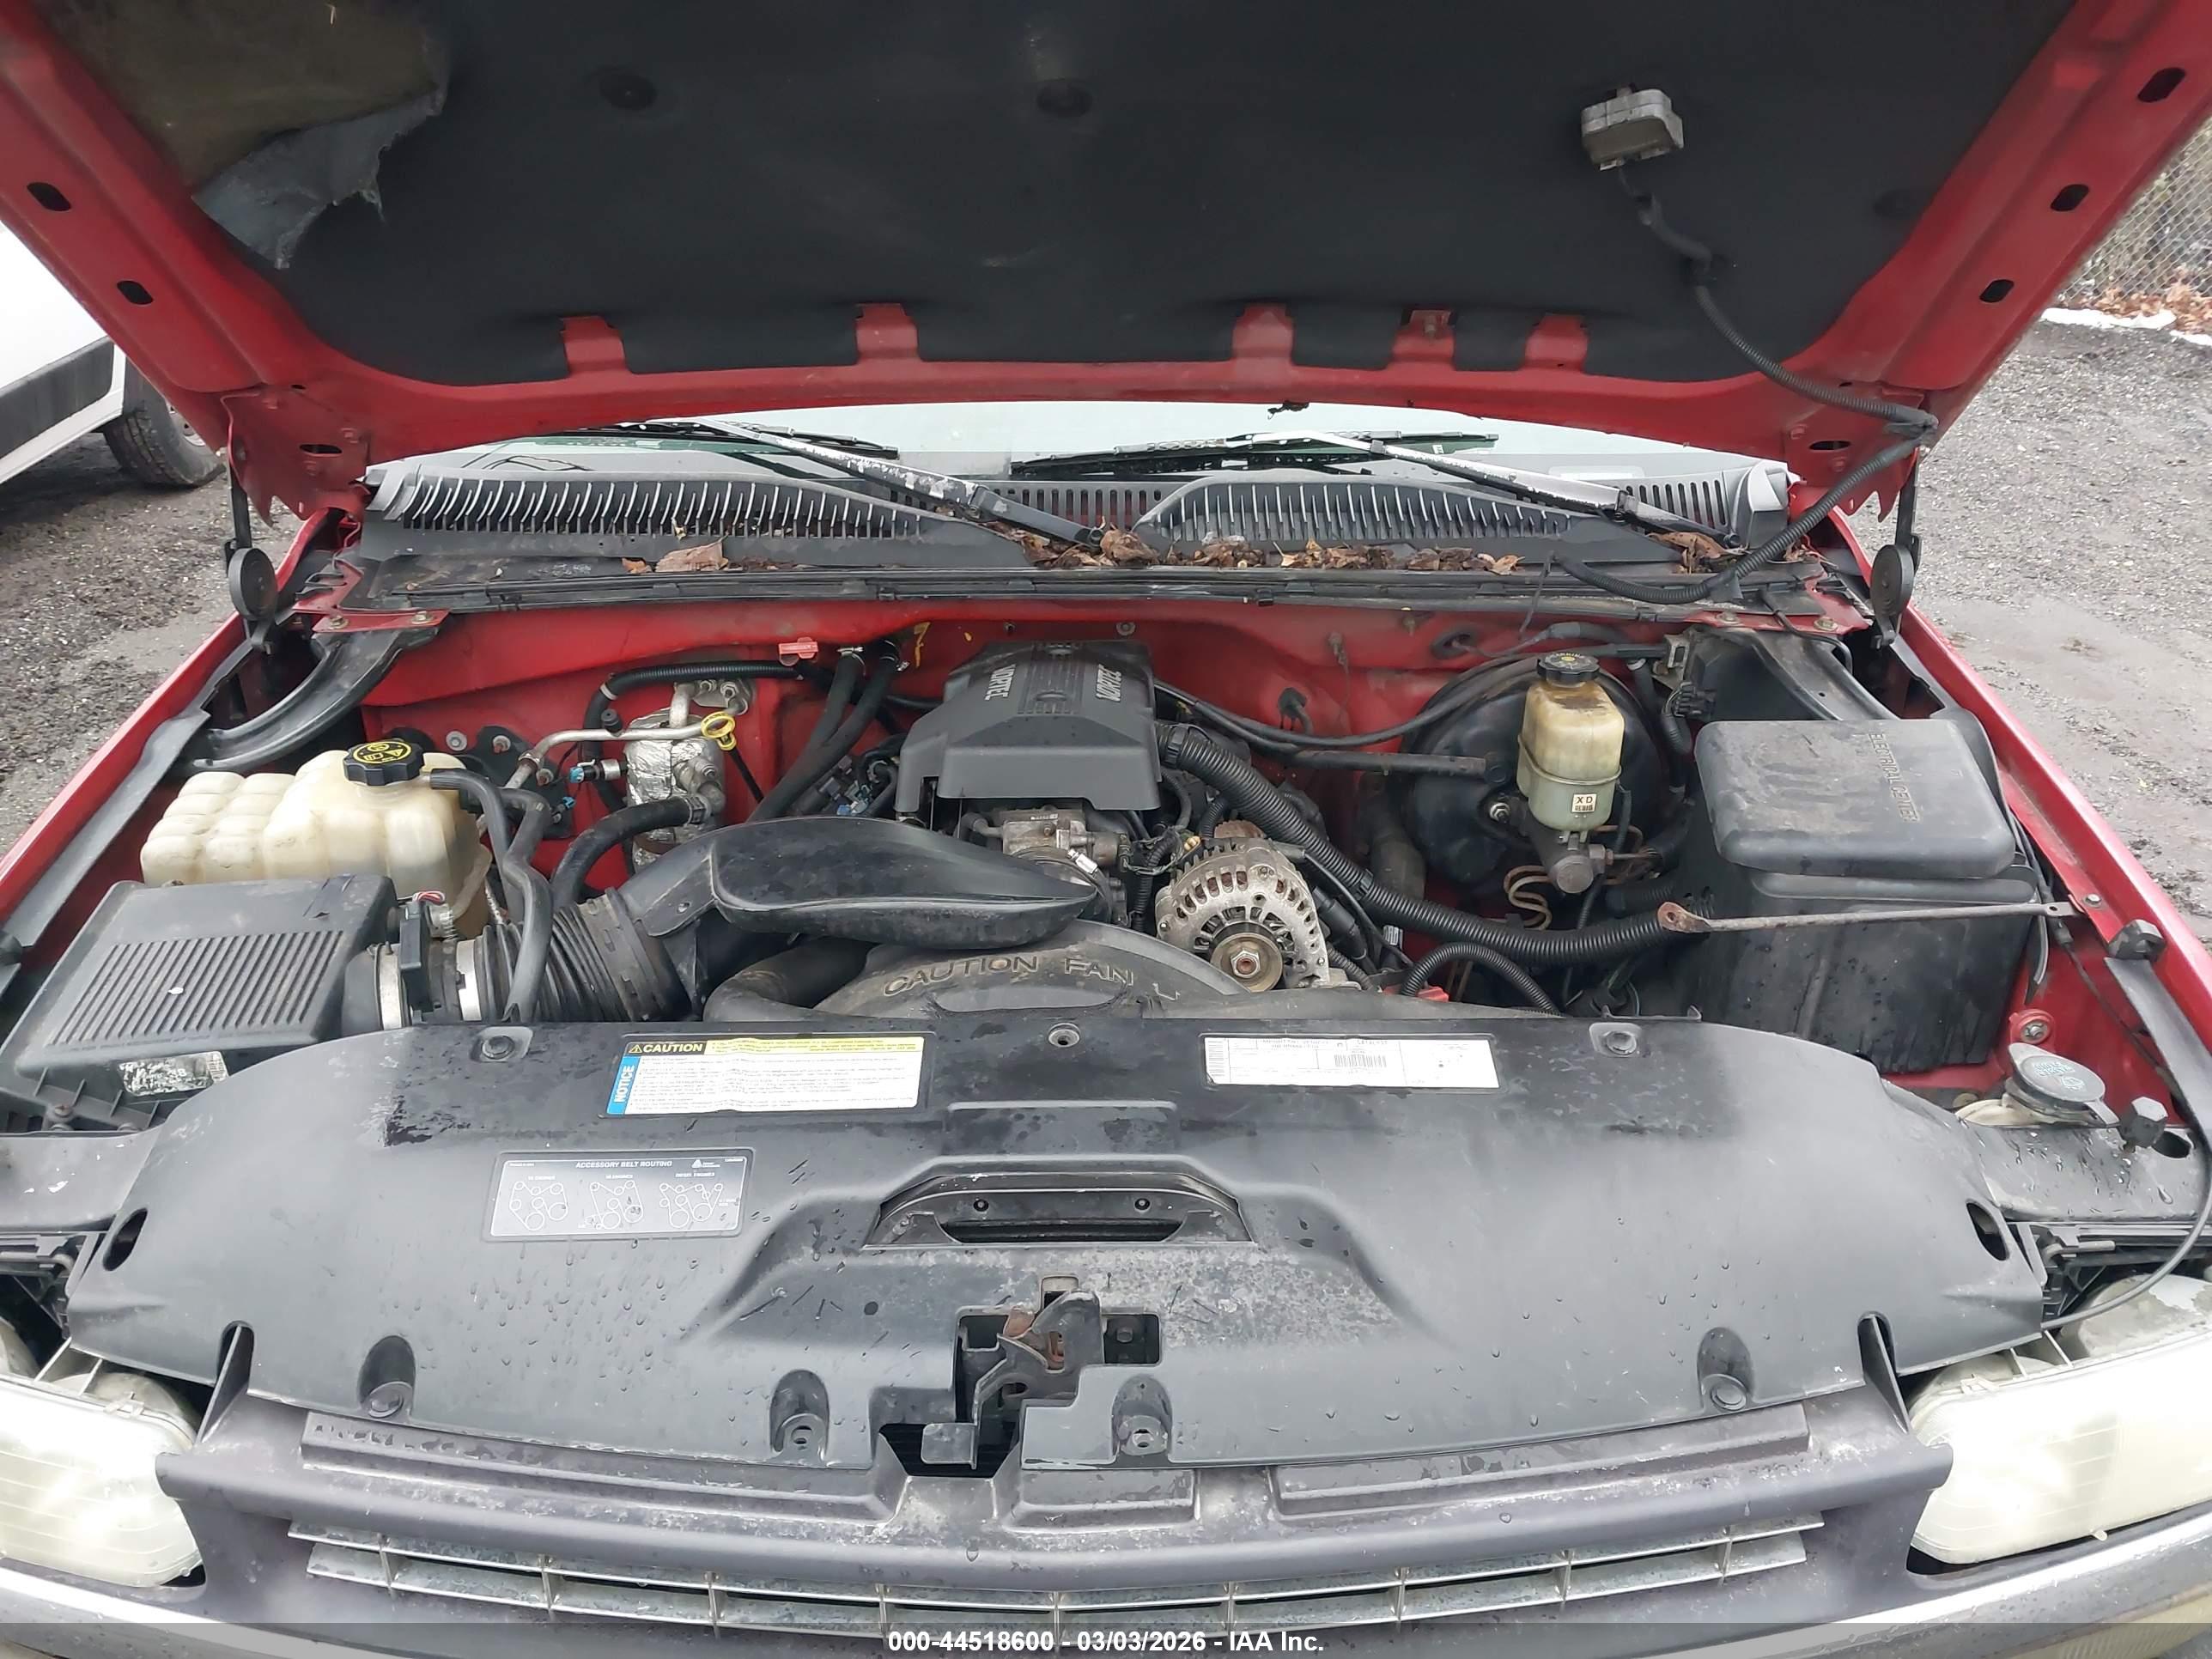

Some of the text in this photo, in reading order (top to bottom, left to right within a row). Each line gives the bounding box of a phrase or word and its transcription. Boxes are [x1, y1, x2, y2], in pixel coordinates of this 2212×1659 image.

[983, 663, 1016, 701] VORTEC
[1095, 663, 1123, 702] VORTEC
[1868, 732, 1902, 785] ELECTRICAL
[883, 955, 1134, 997] CAUTION FAN
[642, 1043, 703, 1053] CAUTION
[613, 1064, 636, 1104] NOTICE
